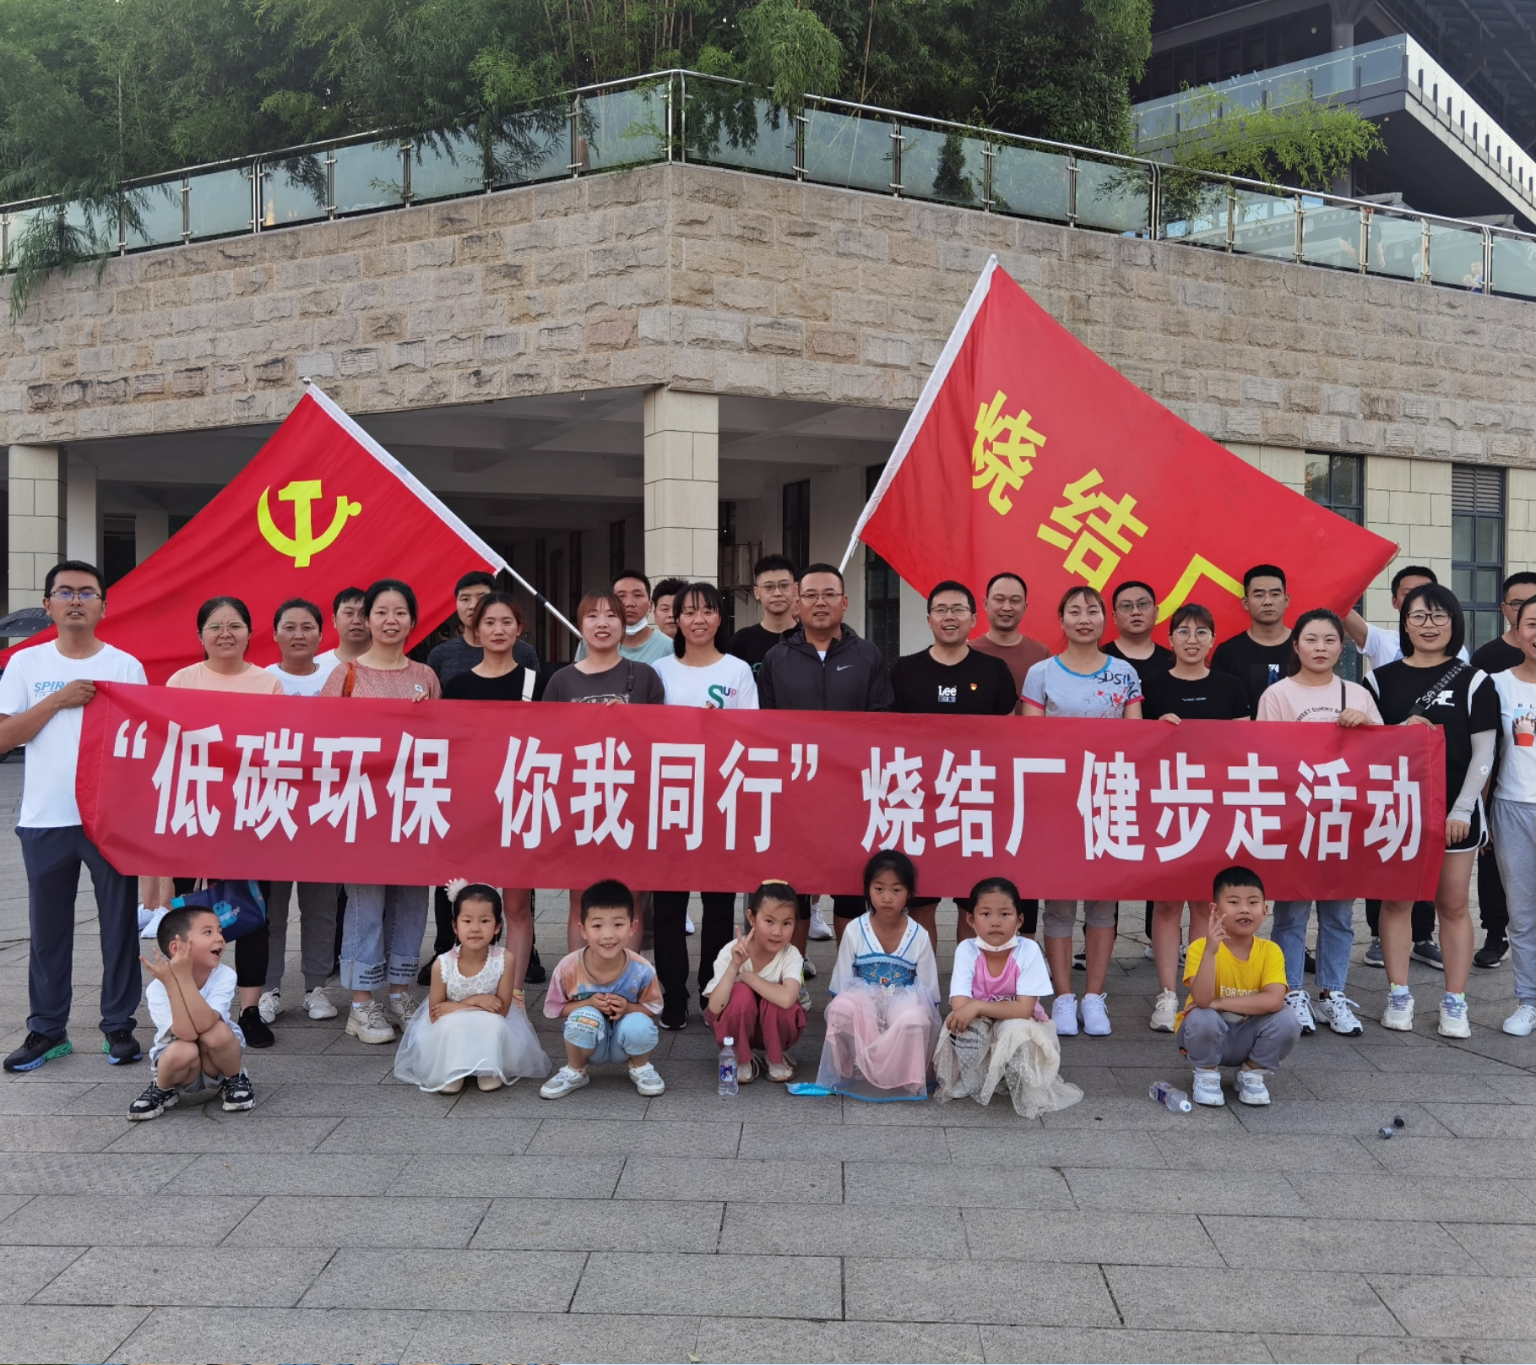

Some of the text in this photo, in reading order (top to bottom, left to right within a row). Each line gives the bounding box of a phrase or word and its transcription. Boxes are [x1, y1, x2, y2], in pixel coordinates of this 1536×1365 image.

[971, 390, 1243, 625] 烧结厂
[34, 681, 67, 693] SPIR
[938, 685, 957, 696] Lee
[113, 719, 1422, 863] “低碳环保 你我同行” 烧结厂健步走活动
